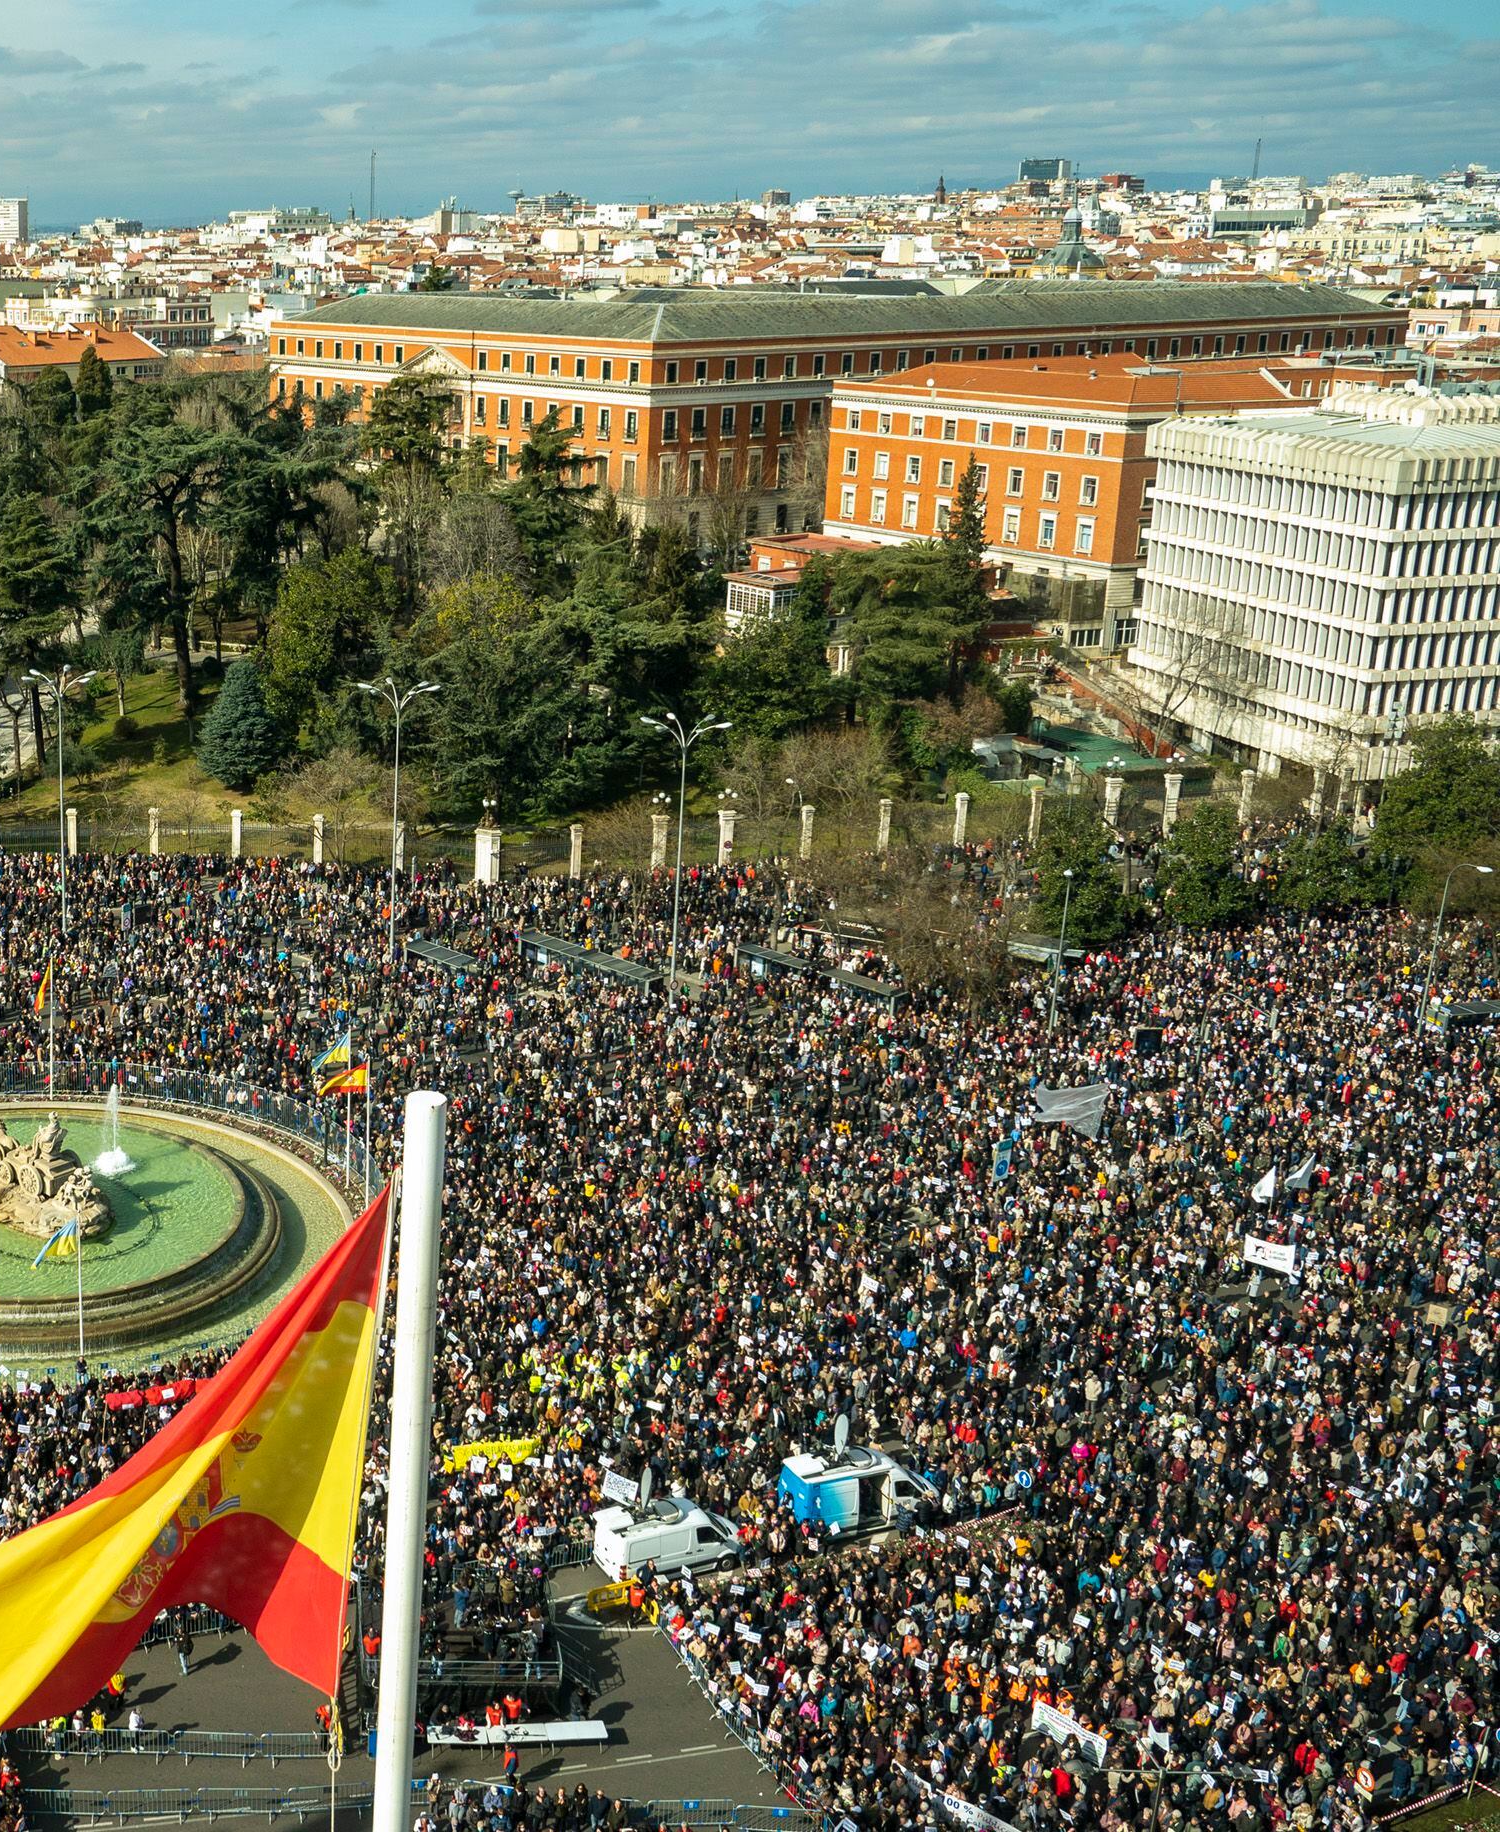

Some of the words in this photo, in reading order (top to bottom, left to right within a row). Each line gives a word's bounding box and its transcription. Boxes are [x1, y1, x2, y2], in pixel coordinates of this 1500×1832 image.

[767, 1727, 782, 1743] NO
[941, 1796, 960, 1810] 100
[963, 1804, 974, 1816] %
